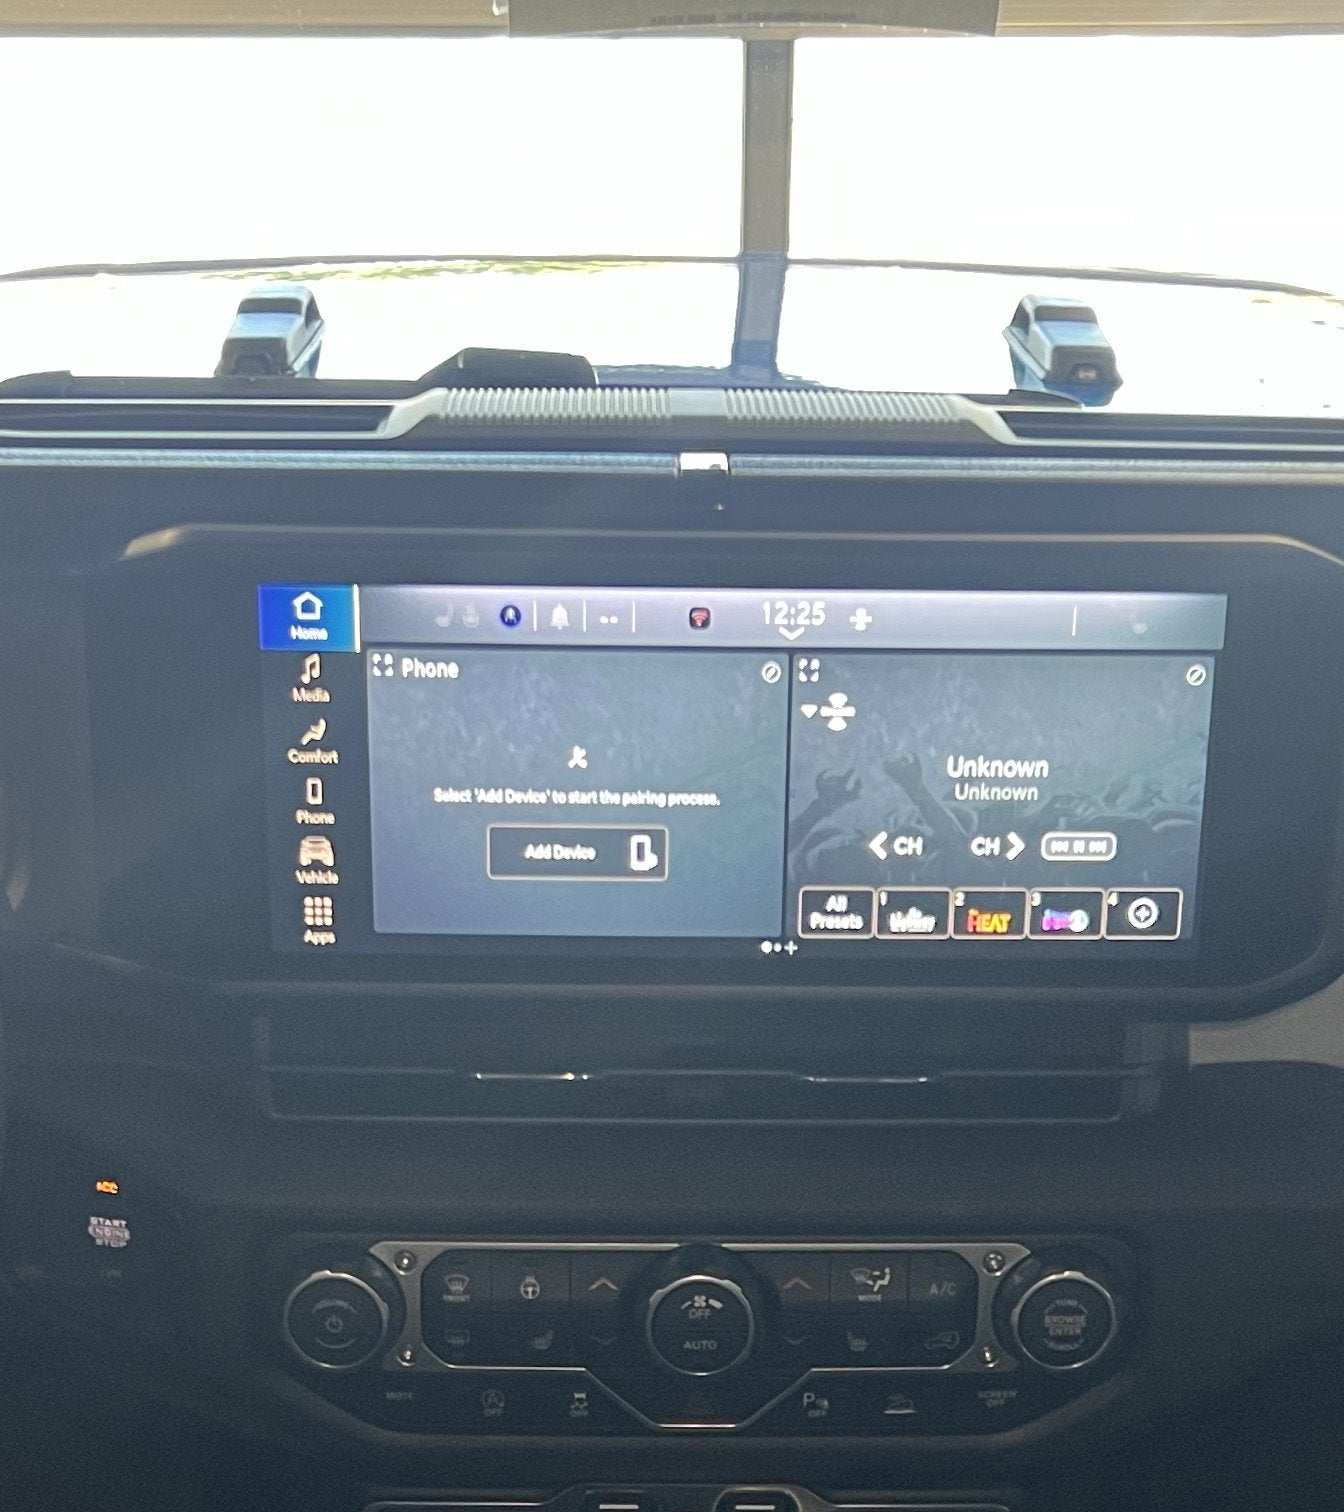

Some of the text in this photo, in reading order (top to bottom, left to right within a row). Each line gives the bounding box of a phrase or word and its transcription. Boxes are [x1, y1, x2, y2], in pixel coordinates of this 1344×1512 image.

[762, 600, 826, 626] 12:25
[290, 625, 328, 641] Home
[401, 657, 459, 679] Phone
[292, 686, 330, 703] Media
[287, 748, 339, 764] Comfort
[946, 756, 1049, 779] Unknown
[433, 787, 472, 804] Select
[551, 790, 566, 805] to
[567, 790, 598, 805] start
[599, 789, 620, 805] the
[622, 789, 666, 808] pairing
[668, 792, 720, 808] process.
[954, 783, 1038, 801] Unknown
[296, 809, 335, 825] Phone
[525, 844, 597, 860] Add Device
[894, 836, 922, 855] CH
[971, 836, 1000, 855] CH
[294, 869, 339, 885] Vehicle
[826, 894, 848, 912] All
[954, 892, 965, 907] 2
[1031, 892, 1041, 907] 3
[1106, 891, 1118, 907] 4
[810, 911, 864, 931] Presets
[967, 912, 1014, 933] HEAT
[303, 928, 336, 946] Apps
[90, 1216, 127, 1228] START
[95, 1238, 127, 1248] STOP
[928, 1282, 957, 1297] A/C
[688, 1309, 711, 1320] OFF
[1044, 1315, 1087, 1325] BROWSE
[1049, 1326, 1082, 1336] ENTER
[683, 1339, 718, 1351] AUTO
